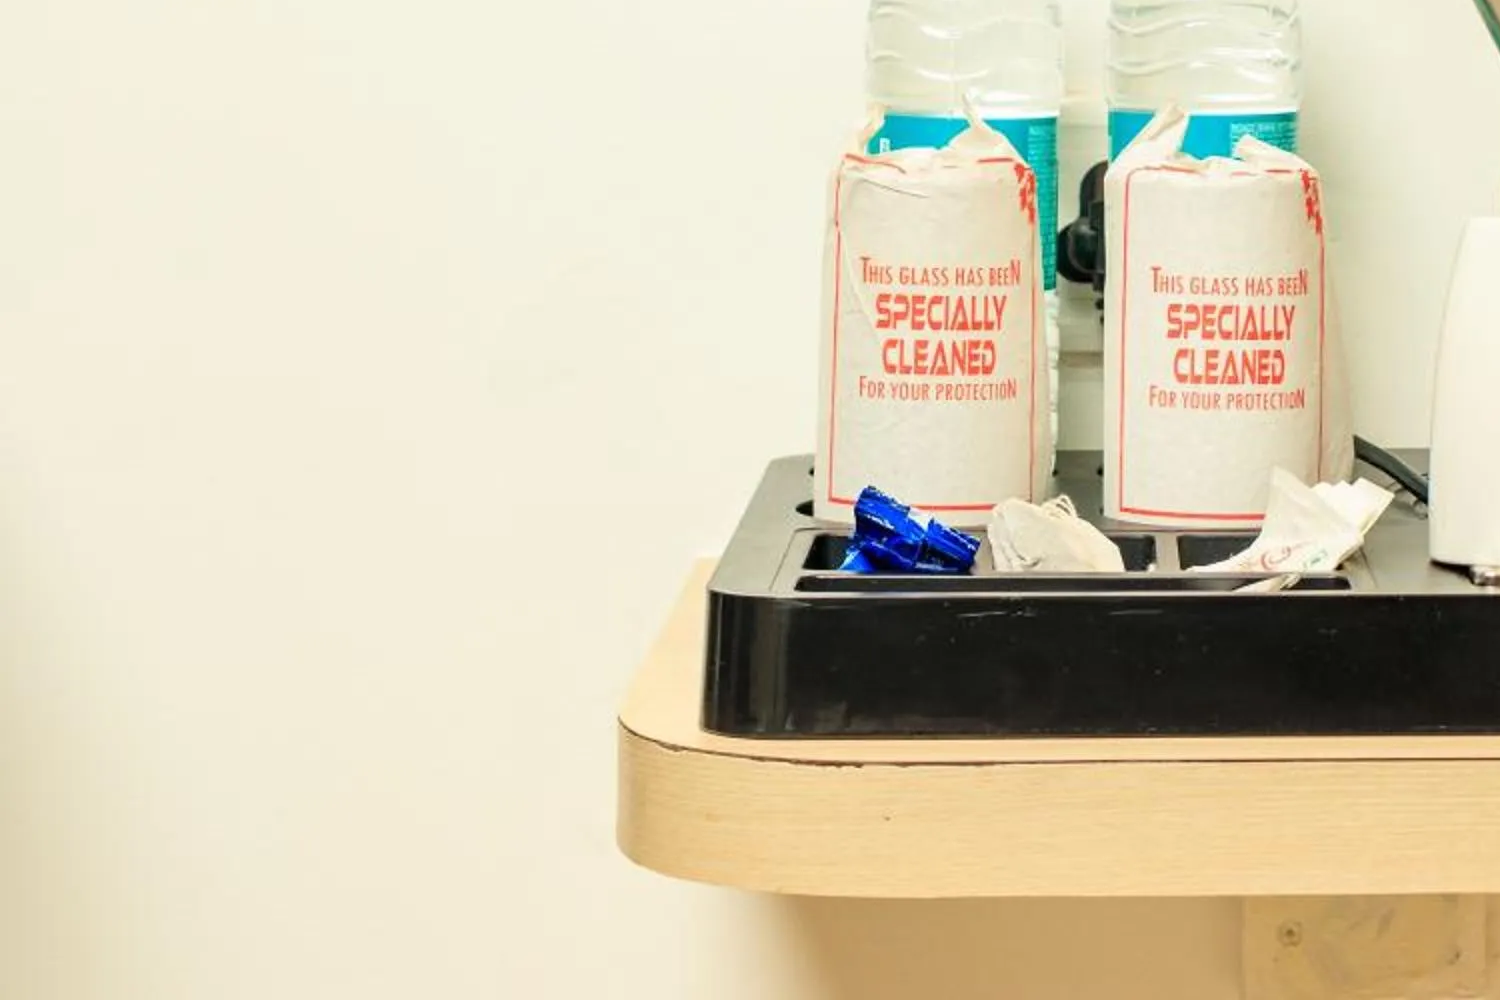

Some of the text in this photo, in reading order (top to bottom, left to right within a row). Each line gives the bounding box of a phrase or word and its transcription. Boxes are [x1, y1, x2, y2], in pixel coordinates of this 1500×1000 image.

[899, 266, 949, 286] GLASS
[955, 267, 983, 286] HAS
[1189, 276, 1239, 296] GLASS
[1245, 277, 1273, 297] HAS
[875, 293, 1007, 331] SPECIALLY
[1166, 303, 1295, 341] SPECIALLY
[882, 338, 996, 376] CLEANED
[1173, 348, 1286, 385] CLEANED
[890, 382, 930, 401] YOUR
[935, 378, 1017, 402] PROTECTION
[1181, 391, 1220, 410] YOUR
[1227, 389, 1305, 411] PROTECTION
